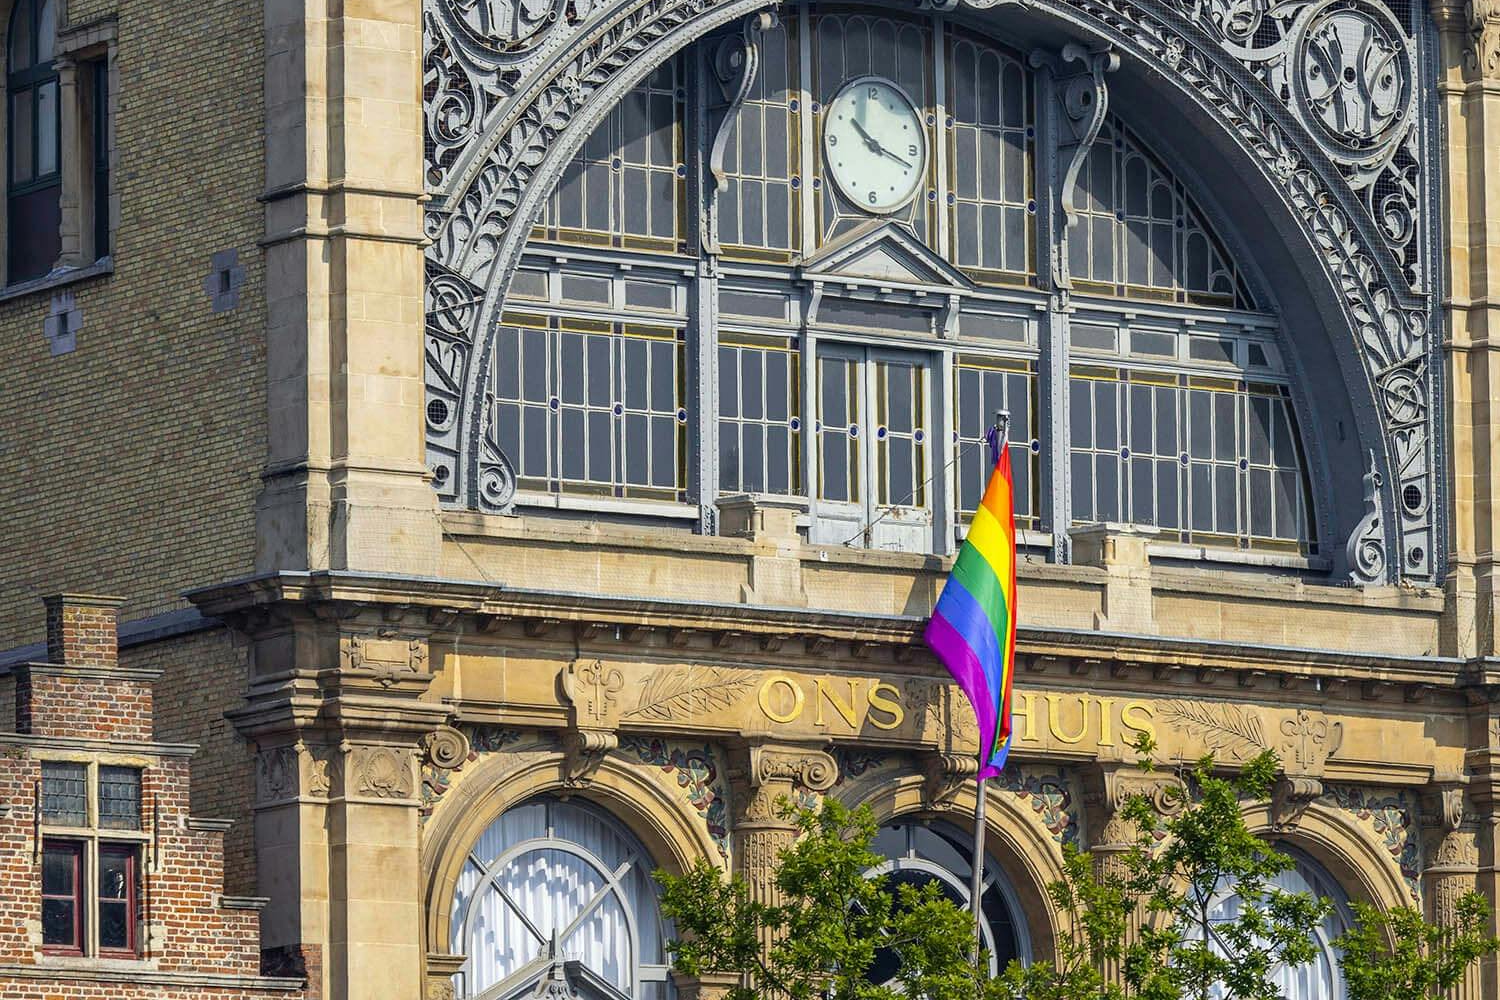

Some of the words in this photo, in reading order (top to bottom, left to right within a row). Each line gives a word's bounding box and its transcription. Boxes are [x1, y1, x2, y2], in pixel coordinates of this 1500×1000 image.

[867, 87, 879, 101] 12
[828, 135, 838, 147] 9
[908, 144, 918, 157] 3
[868, 191, 877, 204] 6
[757, 674, 905, 730] ONS
